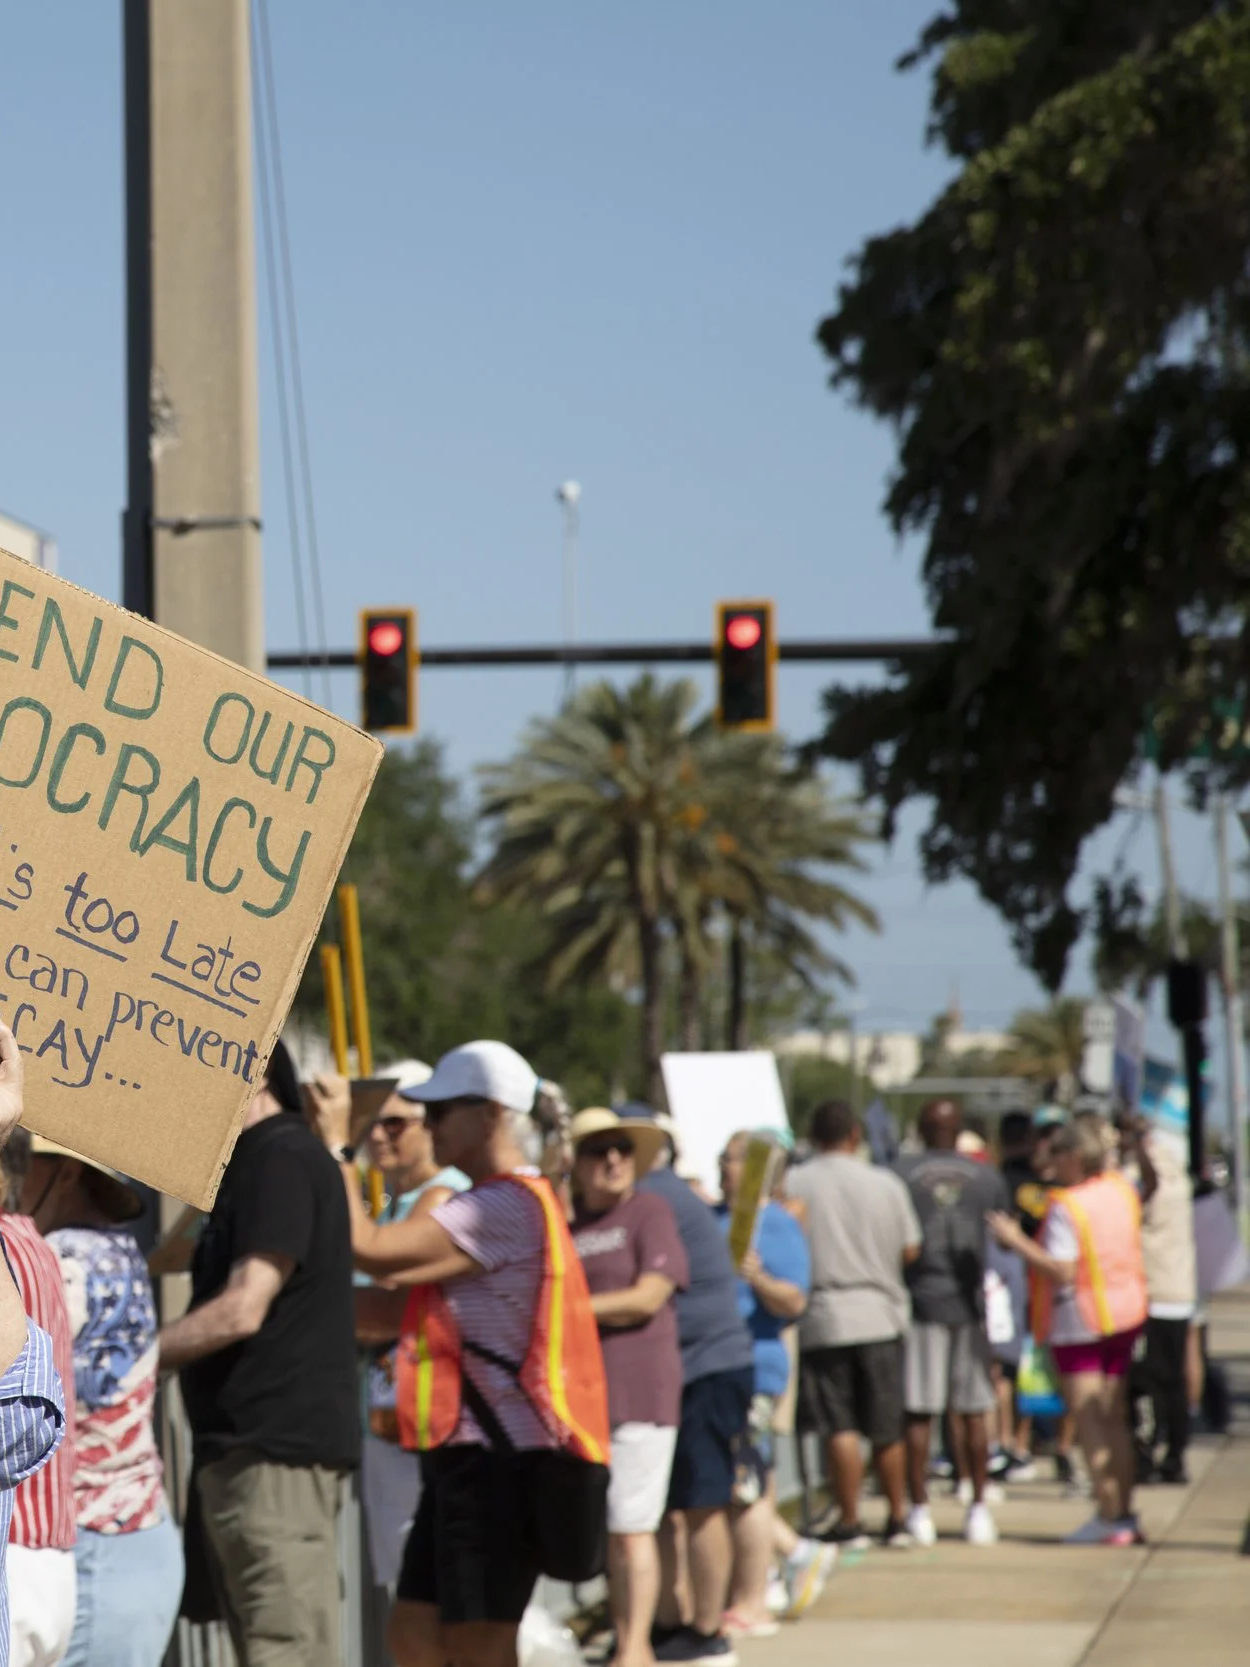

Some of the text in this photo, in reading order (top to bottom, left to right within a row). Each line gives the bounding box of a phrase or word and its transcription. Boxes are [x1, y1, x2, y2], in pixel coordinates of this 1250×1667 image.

[203, 692, 336, 804] OUR
[64, 872, 141, 945] too
[160, 919, 262, 1005] Late
[5, 944, 90, 1010] can
[104, 991, 259, 1084] prevent
